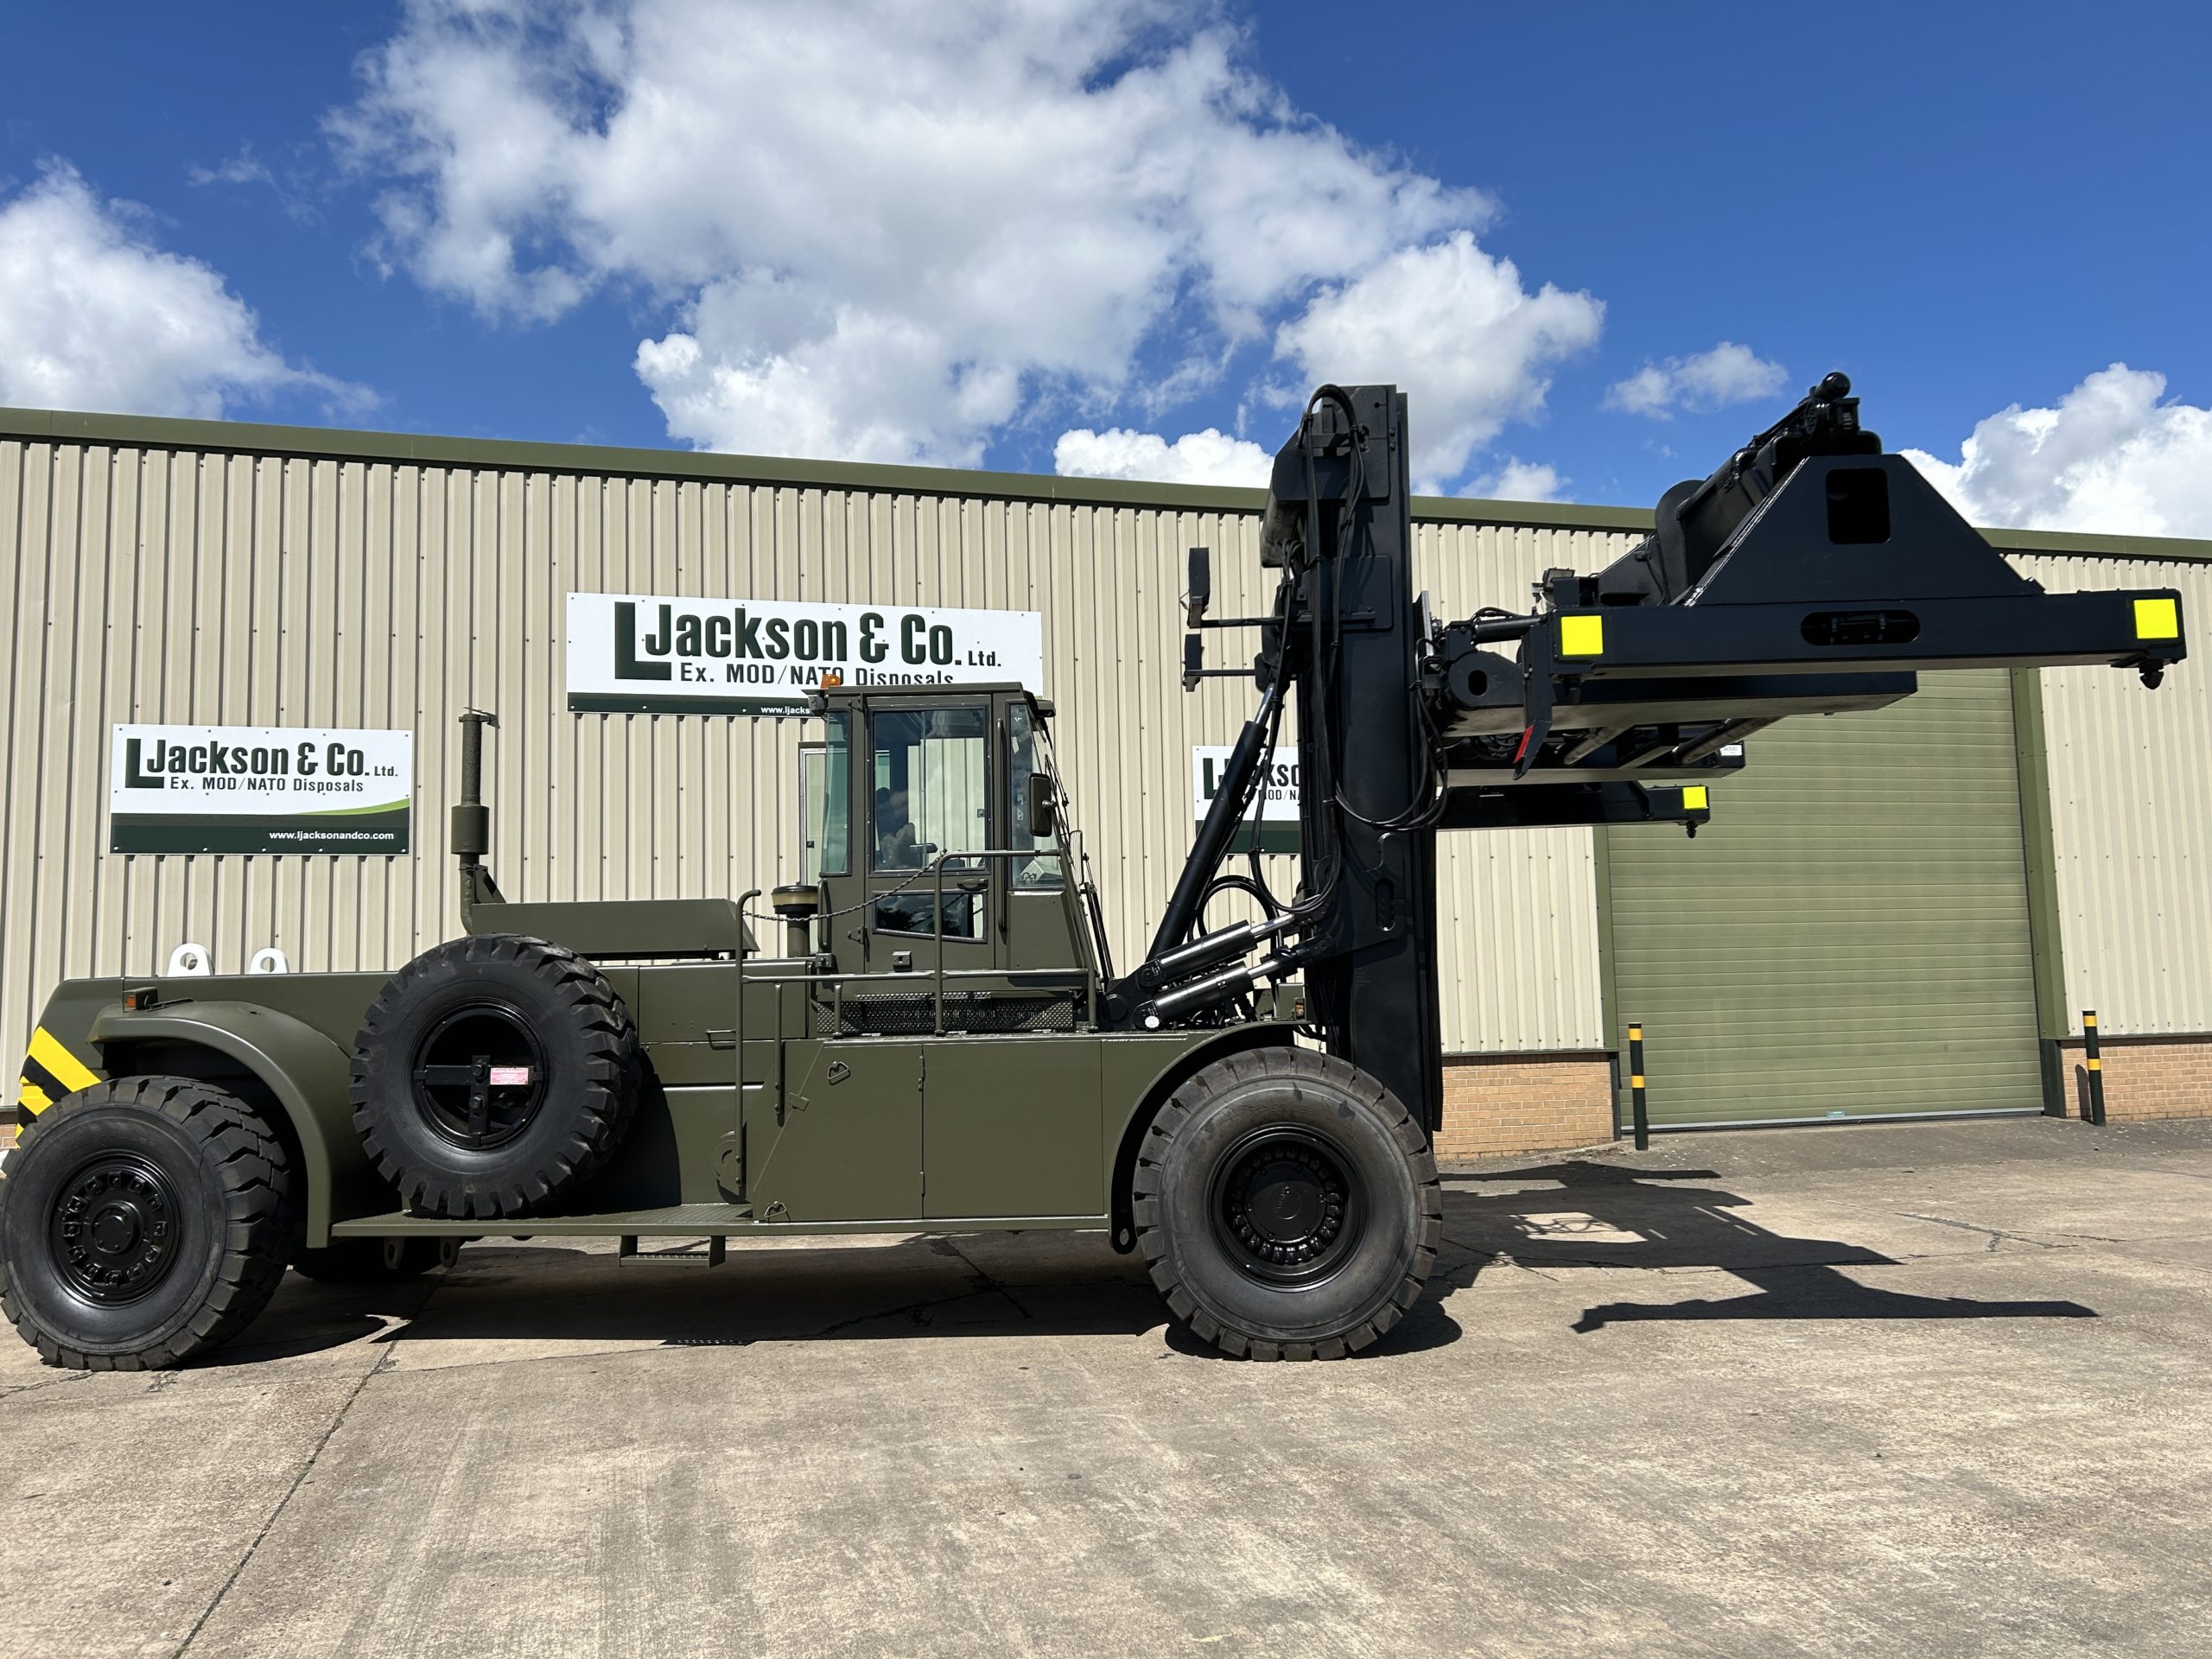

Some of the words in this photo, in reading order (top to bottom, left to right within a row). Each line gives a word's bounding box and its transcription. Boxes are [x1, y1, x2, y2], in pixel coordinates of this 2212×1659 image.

[859, 612, 890, 664] &
[900, 613, 962, 665] Co.
[968, 650, 1001, 667] Ltd.
[680, 662, 715, 683] Ex.
[297, 742, 319, 776] &
[327, 742, 370, 777] Co.
[374, 766, 398, 777] Ltd.
[170, 777, 194, 789] Ex.
[202, 777, 286, 791] MOD/NATO
[293, 779, 364, 793] Disposals
[270, 830, 394, 842] www.ljacksonandco.com
